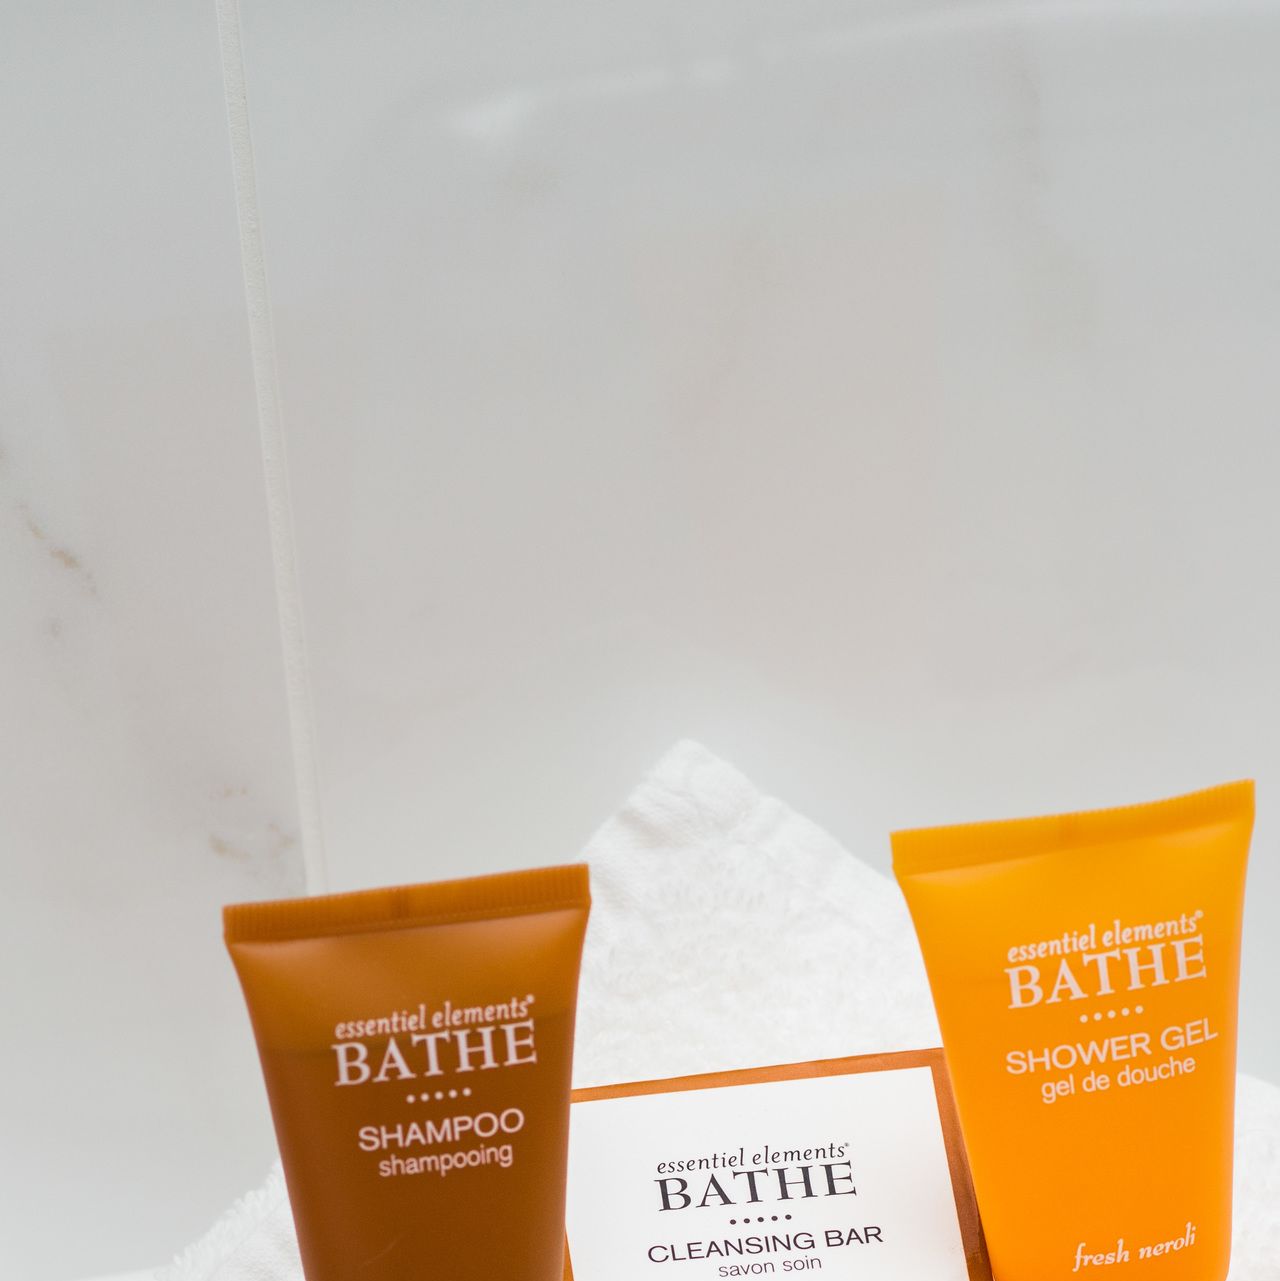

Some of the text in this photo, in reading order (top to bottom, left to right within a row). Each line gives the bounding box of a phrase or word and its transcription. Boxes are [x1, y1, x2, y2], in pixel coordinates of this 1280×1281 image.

[1007, 924, 1097, 963] essentiel
[1004, 934, 1207, 1009] BATHE
[335, 1004, 427, 1039] essentiel
[331, 1018, 537, 1086] BATHE
[1006, 1017, 1219, 1075] SHOWER GEL
[1041, 1055, 1196, 1104] gel de douche
[358, 1107, 524, 1151] SHAMPOO
[378, 1142, 513, 1178] shampooing
[656, 1147, 745, 1175] essentiel
[654, 1159, 858, 1213] BATHE
[646, 1225, 885, 1264] CLEANSING BAR
[718, 1255, 823, 1278] savon soin
[1072, 1222, 1197, 1273] fresh neroli
